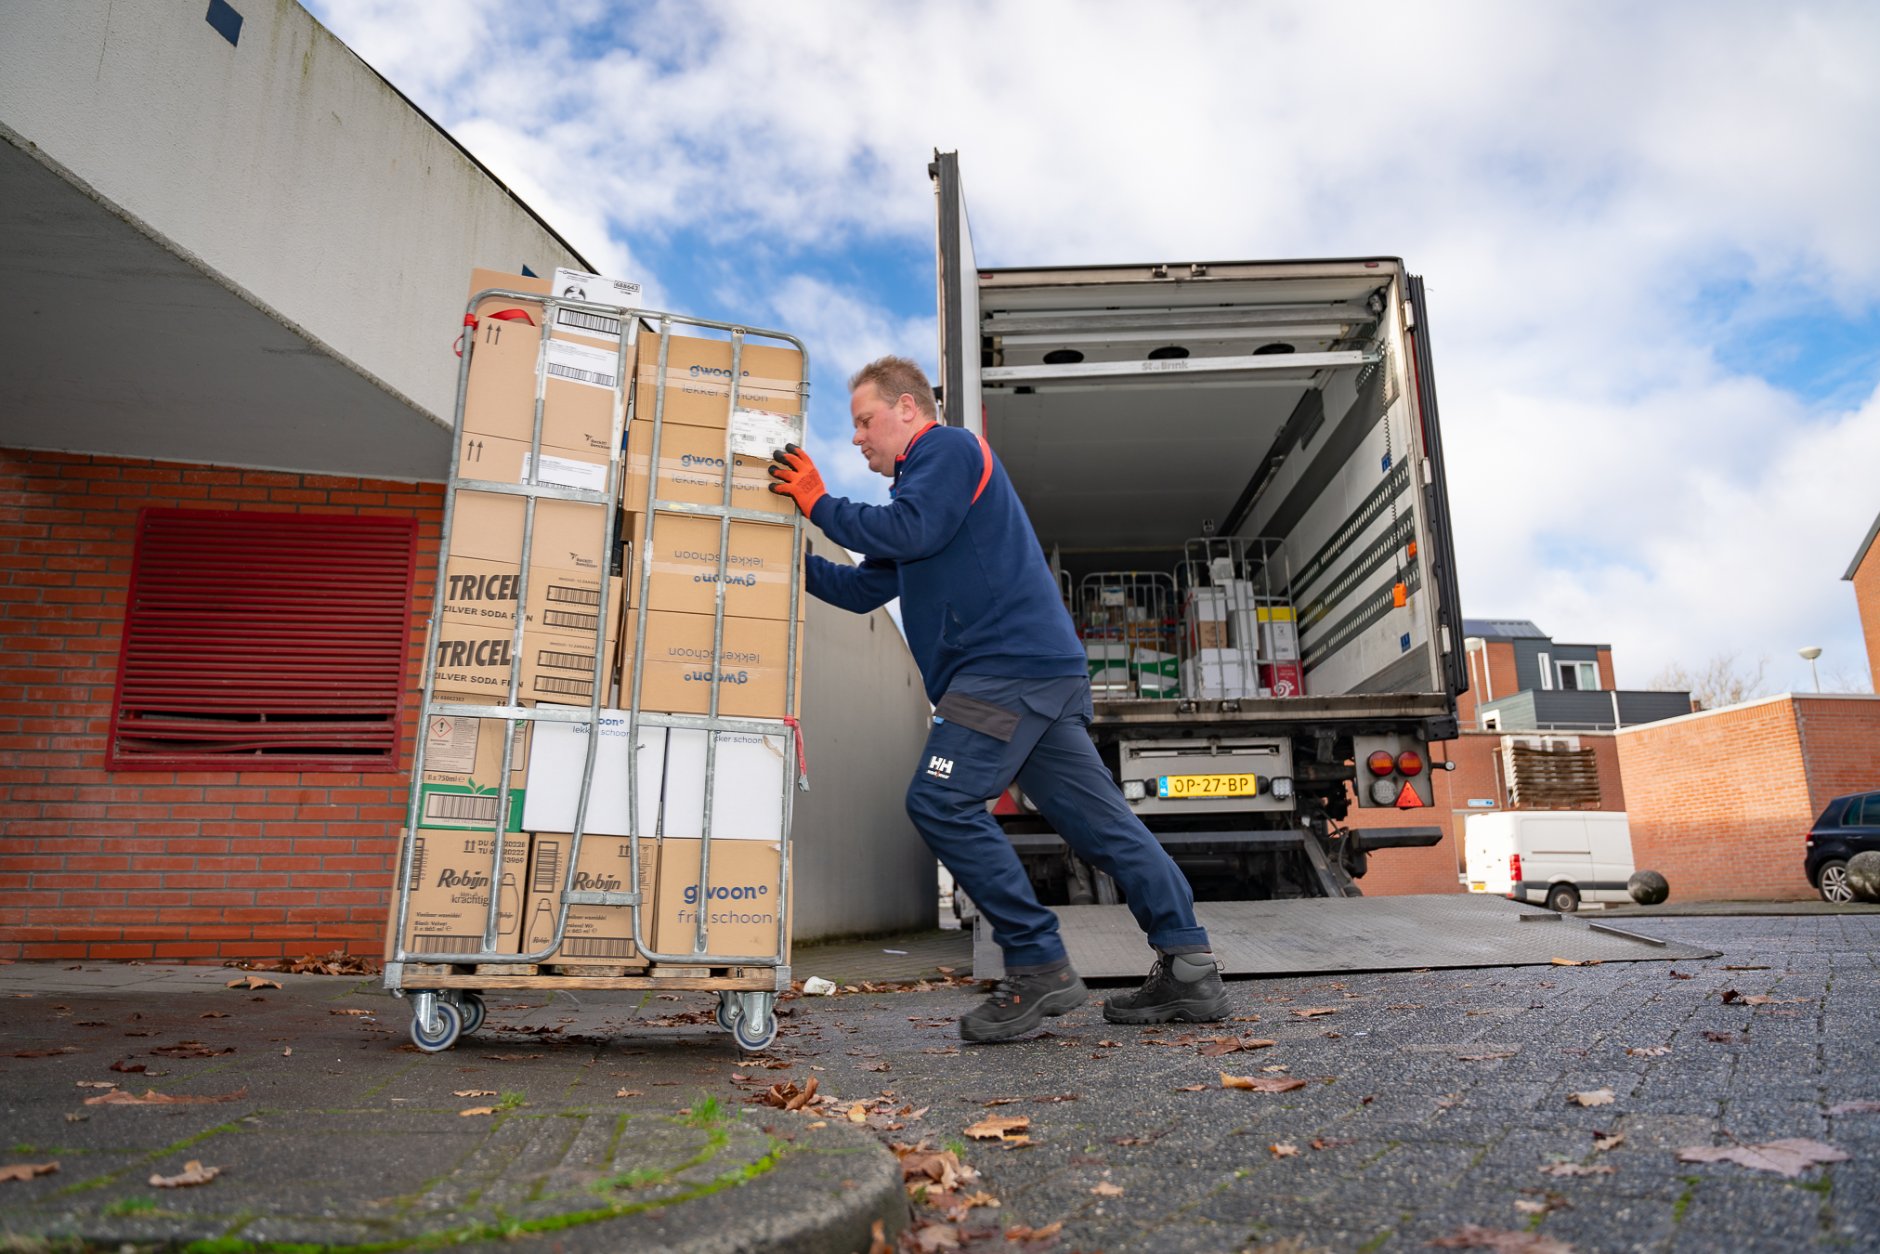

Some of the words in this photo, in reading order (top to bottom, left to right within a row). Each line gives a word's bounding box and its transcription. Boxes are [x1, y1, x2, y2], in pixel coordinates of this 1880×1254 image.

[449, 575, 520, 601] TRICEL
[443, 605, 477, 616] ZILVER
[481, 609, 508, 619] SODA
[511, 612, 533, 622] FN
[438, 640, 511, 667] TRICEL
[470, 675, 498, 686] SODA
[1174, 777, 1248, 793] OP-27-BP
[437, 869, 488, 889] Robijn
[572, 872, 621, 890] Robijn
[452, 894, 488, 907] krachtig
[678, 910, 698, 924] fri
[711, 911, 772, 924] schoon
